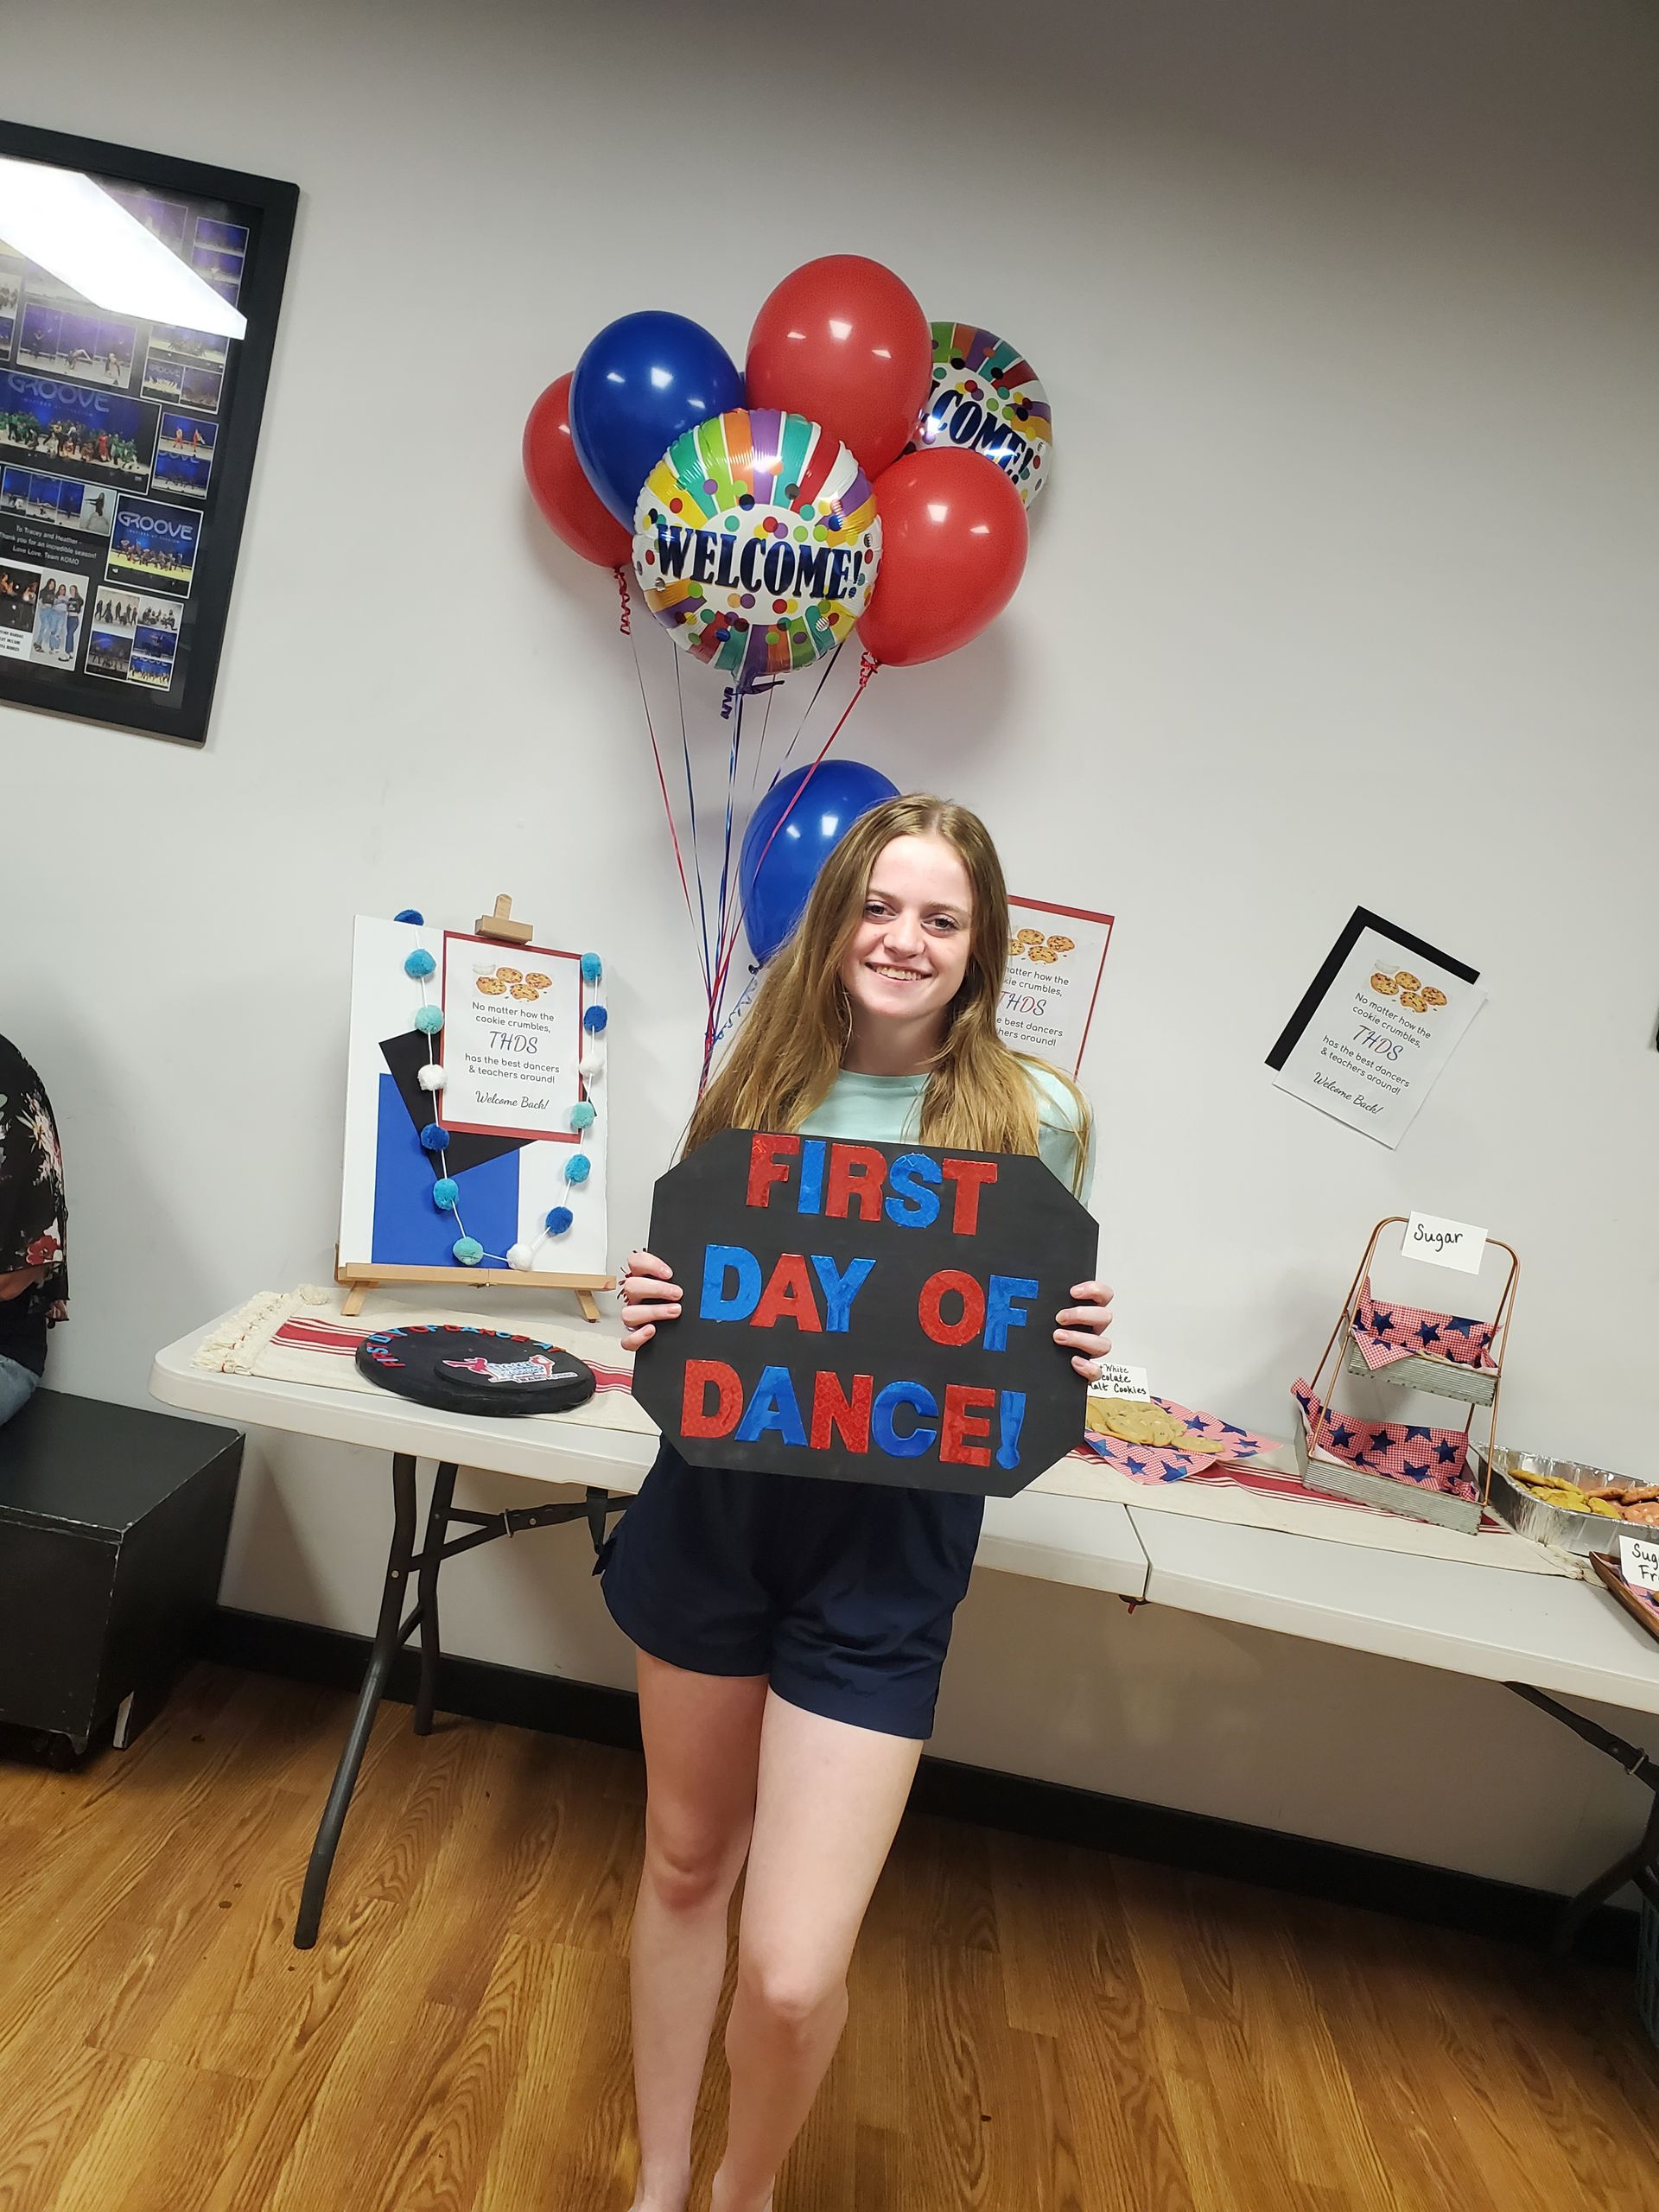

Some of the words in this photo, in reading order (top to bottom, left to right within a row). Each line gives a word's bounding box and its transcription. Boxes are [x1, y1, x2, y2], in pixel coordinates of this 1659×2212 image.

[118, 511, 194, 541] GROOVE
[12, 545, 27, 554] Love
[46, 543, 74, 555] incredible
[55, 534, 78, 545] Heather
[657, 523, 862, 600] WELCOME!
[1019, 981, 1063, 997] crumbles,
[1033, 971, 1052, 982] how
[1054, 976, 1069, 986] the
[472, 1001, 486, 1011] No
[487, 1005, 518, 1015] matter
[520, 1009, 538, 1019] how
[540, 1013, 555, 1021] the
[1355, 993, 1368, 1004] No
[1369, 1001, 1399, 1020] matter
[1398, 1016, 1416, 1031] how
[1417, 1027, 1431, 1039] the
[475, 1015, 505, 1026] cookie
[507, 1020, 551, 1033] crumbles,
[1004, 1017, 1024, 1029] best
[1026, 1022, 1064, 1037] dancers
[1352, 1006, 1381, 1025] cookie
[1382, 1020, 1421, 1048] crumbles,
[489, 1031, 538, 1054] THDS
[1020, 1033, 1057, 1047] around!
[1353, 1024, 1404, 1061] THDS
[465, 1052, 482, 1063] has
[484, 1056, 499, 1065] the
[501, 1058, 521, 1068] best
[523, 1061, 560, 1073] dancers
[1320, 1046, 1328, 1056] &
[1329, 1051, 1366, 1077] teachers
[1366, 1073, 1402, 1096] around!
[1322, 1035, 1339, 1049] has
[1340, 1045, 1354, 1058] the
[1355, 1052, 1375, 1069] best
[1375, 1065, 1410, 1088] dancers
[468, 1065, 476, 1073] &
[478, 1067, 518, 1079] teachers
[520, 1073, 555, 1084] around!
[475, 1090, 518, 1107] Welcome
[520, 1096, 550, 1109] Back!
[1313, 1071, 1352, 1101] Welcome
[1353, 1094, 1384, 1115] Back!
[746, 1133, 998, 1236] FIRST
[1414, 1224, 1463, 1252] Sugar
[699, 1244, 876, 1333] DAY
[918, 1269, 1039, 1351] OF
[1102, 1373, 1131, 1382] colate
[1114, 1382, 1147, 1395] Cookies
[680, 1359, 1027, 1469] DANCE!
[1631, 1543, 1659, 1570] Sug
[1638, 1564, 1659, 1581] Fr
